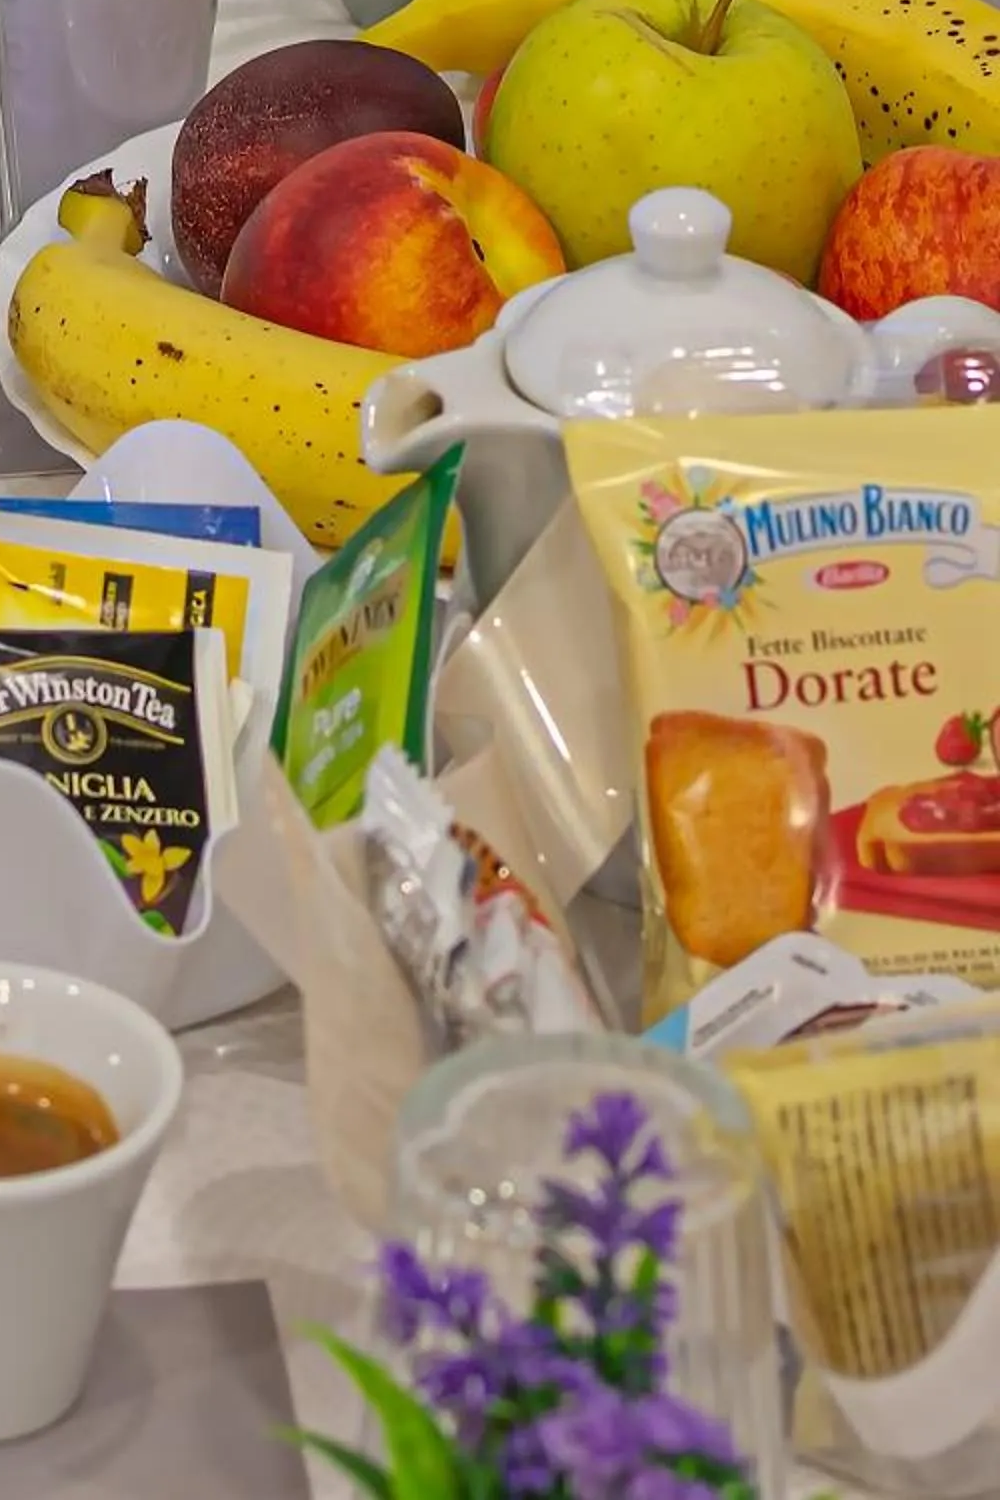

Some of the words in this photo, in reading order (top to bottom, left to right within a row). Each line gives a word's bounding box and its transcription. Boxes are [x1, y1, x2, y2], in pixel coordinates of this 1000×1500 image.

[747, 636, 805, 657] Fette
[812, 625, 927, 653] Biscottate
[742, 659, 939, 712] Dorate
[45, 771, 156, 803] NIGLIA
[100, 803, 200, 827] ZENZERO
